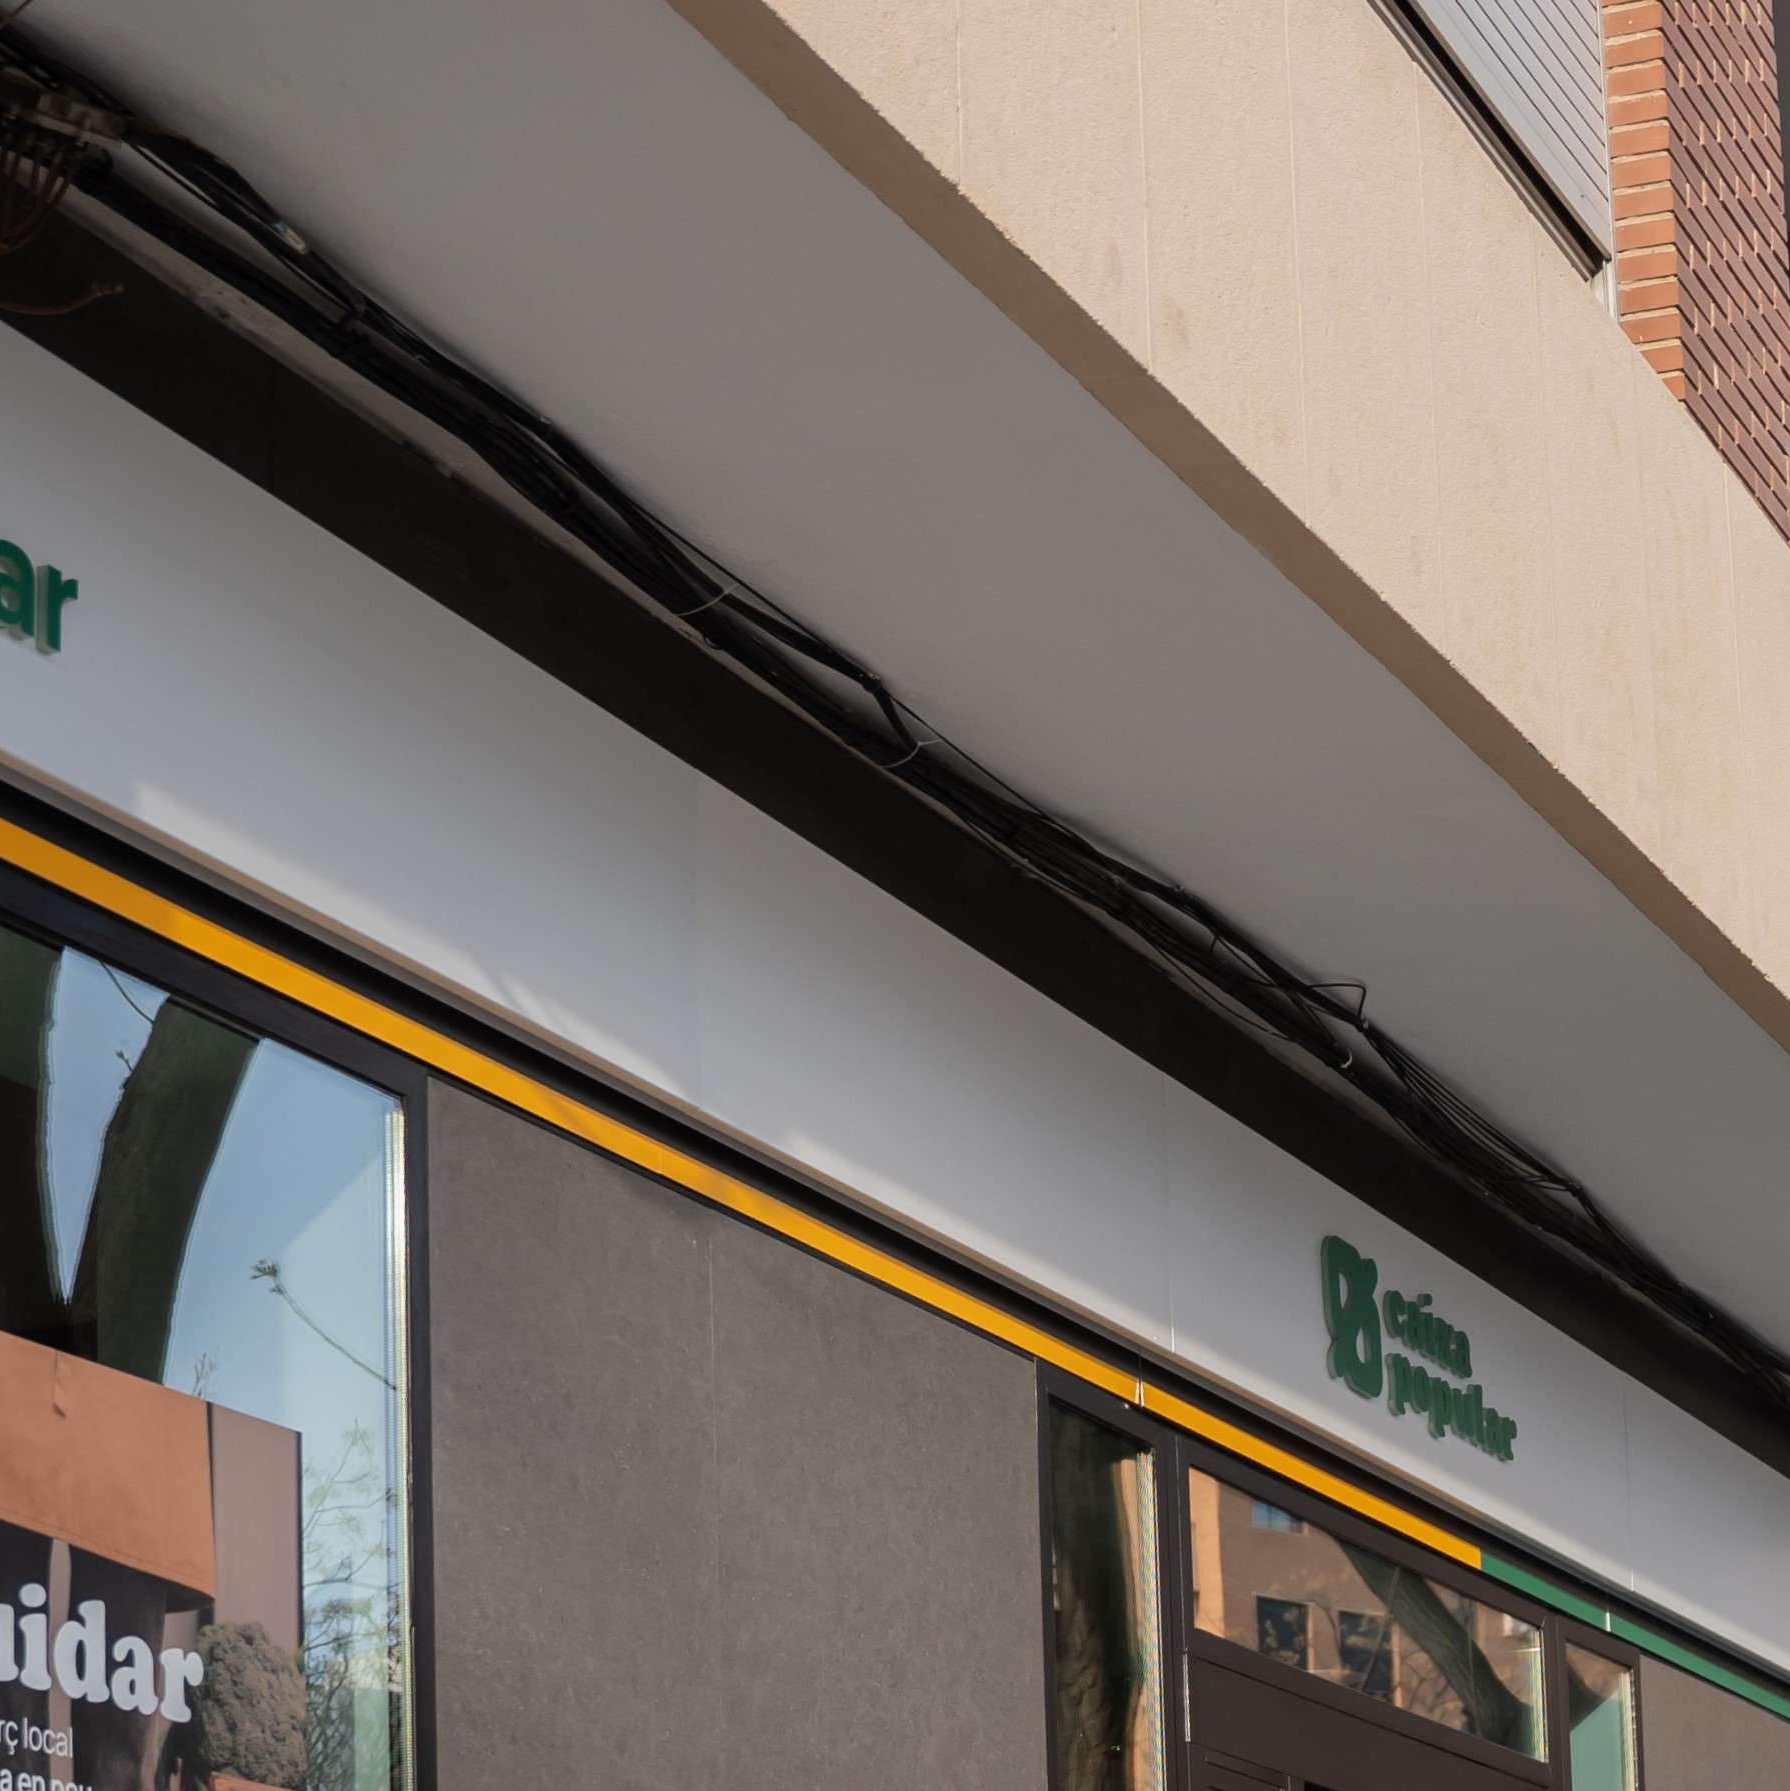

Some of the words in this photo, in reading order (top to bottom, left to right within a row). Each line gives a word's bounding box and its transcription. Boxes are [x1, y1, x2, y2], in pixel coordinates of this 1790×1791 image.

[1383, 1290, 1472, 1379] caixa
[1386, 1352, 1517, 1462] popular
[22, 1718, 74, 1758] local
